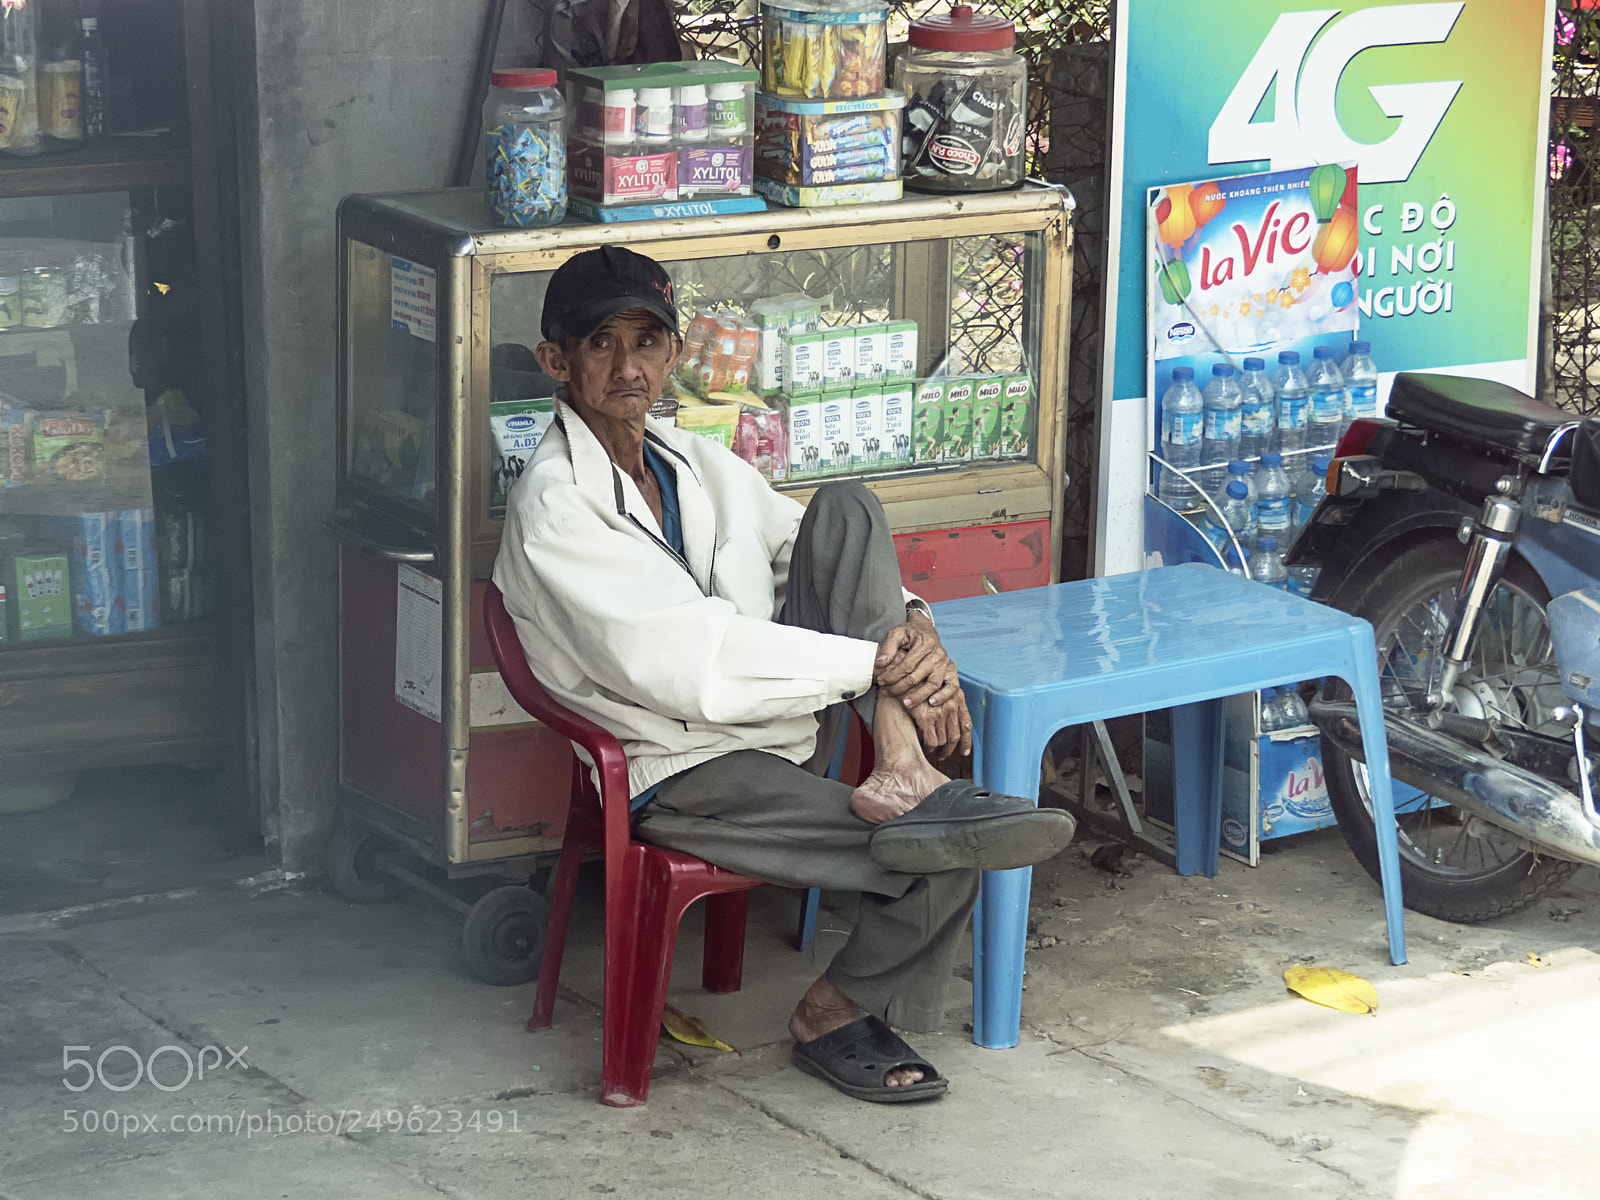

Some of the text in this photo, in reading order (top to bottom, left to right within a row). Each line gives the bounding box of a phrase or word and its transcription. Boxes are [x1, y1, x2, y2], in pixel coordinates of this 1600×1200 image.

[1207, 2, 1466, 184] 4G
[835, 101, 879, 112] mentos
[947, 149, 977, 163] Choco
[574, 168, 604, 184] XYLITO
[618, 173, 667, 188] XYLITOL
[693, 167, 741, 180] XYLITOL
[664, 203, 717, 217] XYLITOL
[1400, 192, 1457, 236] ĐỘ
[1391, 237, 1455, 276] NƠI
[921, 391, 940, 400] MILO
[950, 389, 969, 399] MILO
[979, 387, 999, 396] MILO
[1008, 385, 1027, 394] MILO
[1568, 512, 1597, 526] HONDA
